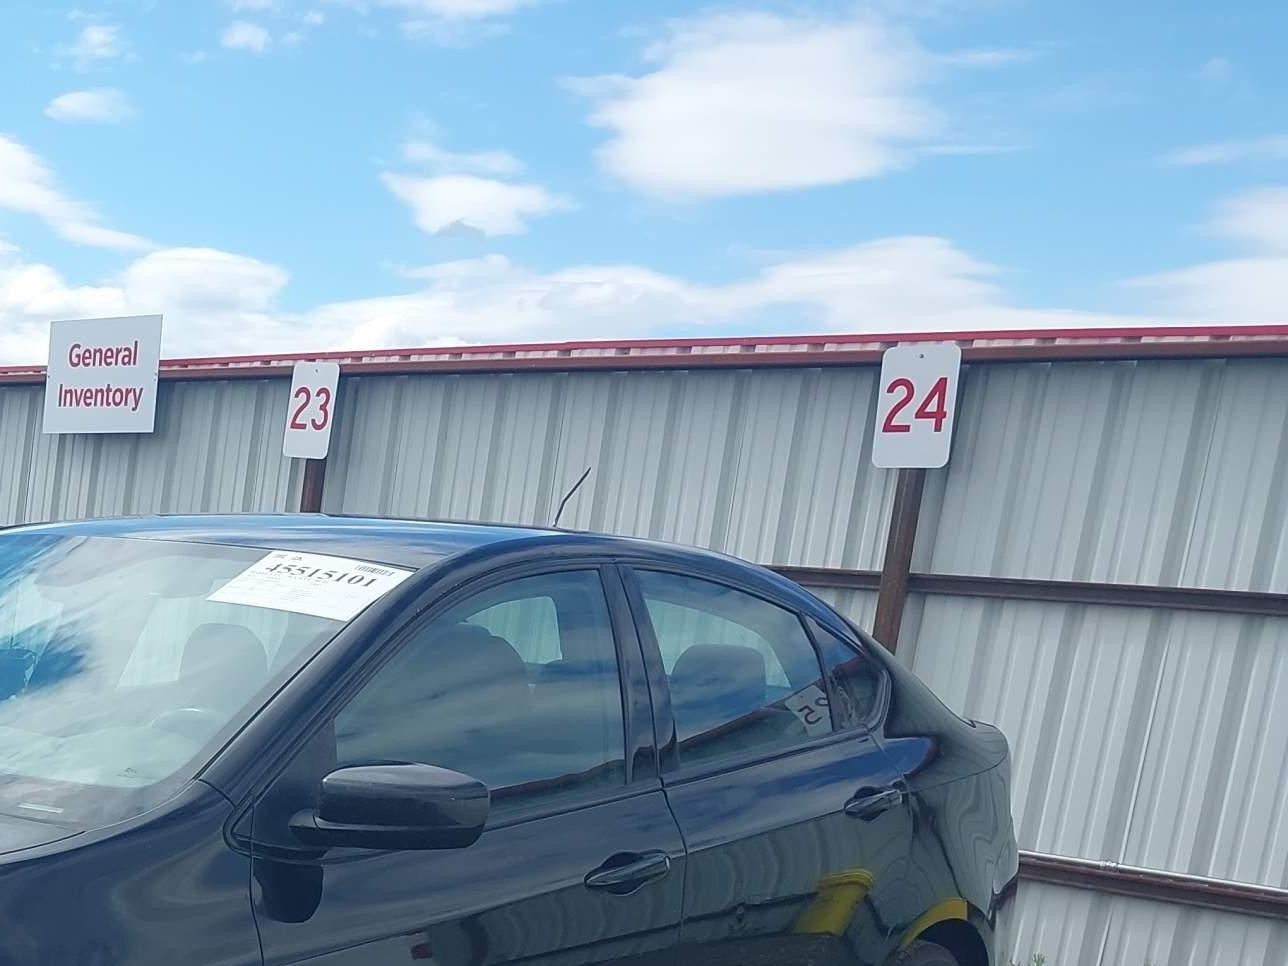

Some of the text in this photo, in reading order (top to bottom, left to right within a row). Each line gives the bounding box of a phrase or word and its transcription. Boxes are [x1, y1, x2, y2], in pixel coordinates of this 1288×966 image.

[68, 340, 139, 368] General
[57, 383, 144, 412] Inventory
[290, 386, 331, 431] 23
[881, 377, 949, 433] 24
[265, 563, 377, 587] 45515101
